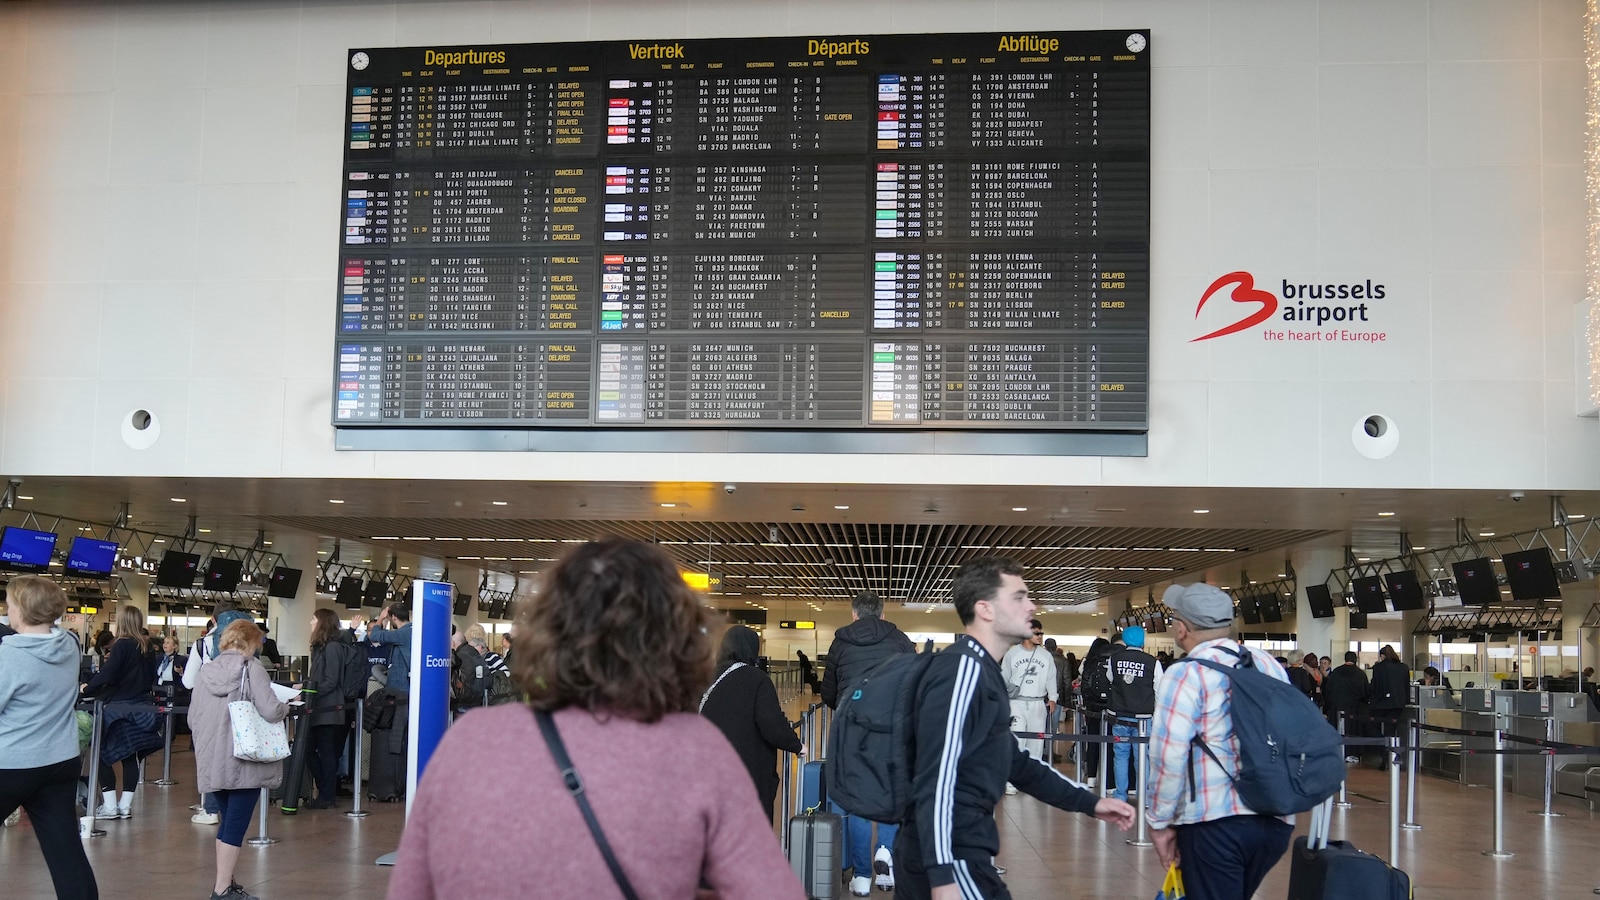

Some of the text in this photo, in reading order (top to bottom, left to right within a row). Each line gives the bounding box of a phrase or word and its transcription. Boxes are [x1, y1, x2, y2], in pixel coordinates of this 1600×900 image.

[808, 39, 869, 58] Départs
[998, 35, 1059, 55] Abflüge
[629, 43, 684, 59] Vertrek
[425, 49, 506, 68] Departures
[1282, 279, 1386, 299] brussels
[1283, 300, 1368, 326] airport
[1005, 320, 1033, 328] MUNICH
[1264, 330, 1386, 343] the heart of Europe
[726, 373, 753, 381] MADRID
[726, 392, 756, 400] VILNIUS
[1004, 393, 1050, 401] CASABLANCA
[2, 552, 11, 560] Bag
[121, 558, 132, 568] 6.2
[143, 561, 154, 571] 6.3
[1117, 661, 1145, 670] GUCCI
[1117, 668, 1143, 677] TIGER
